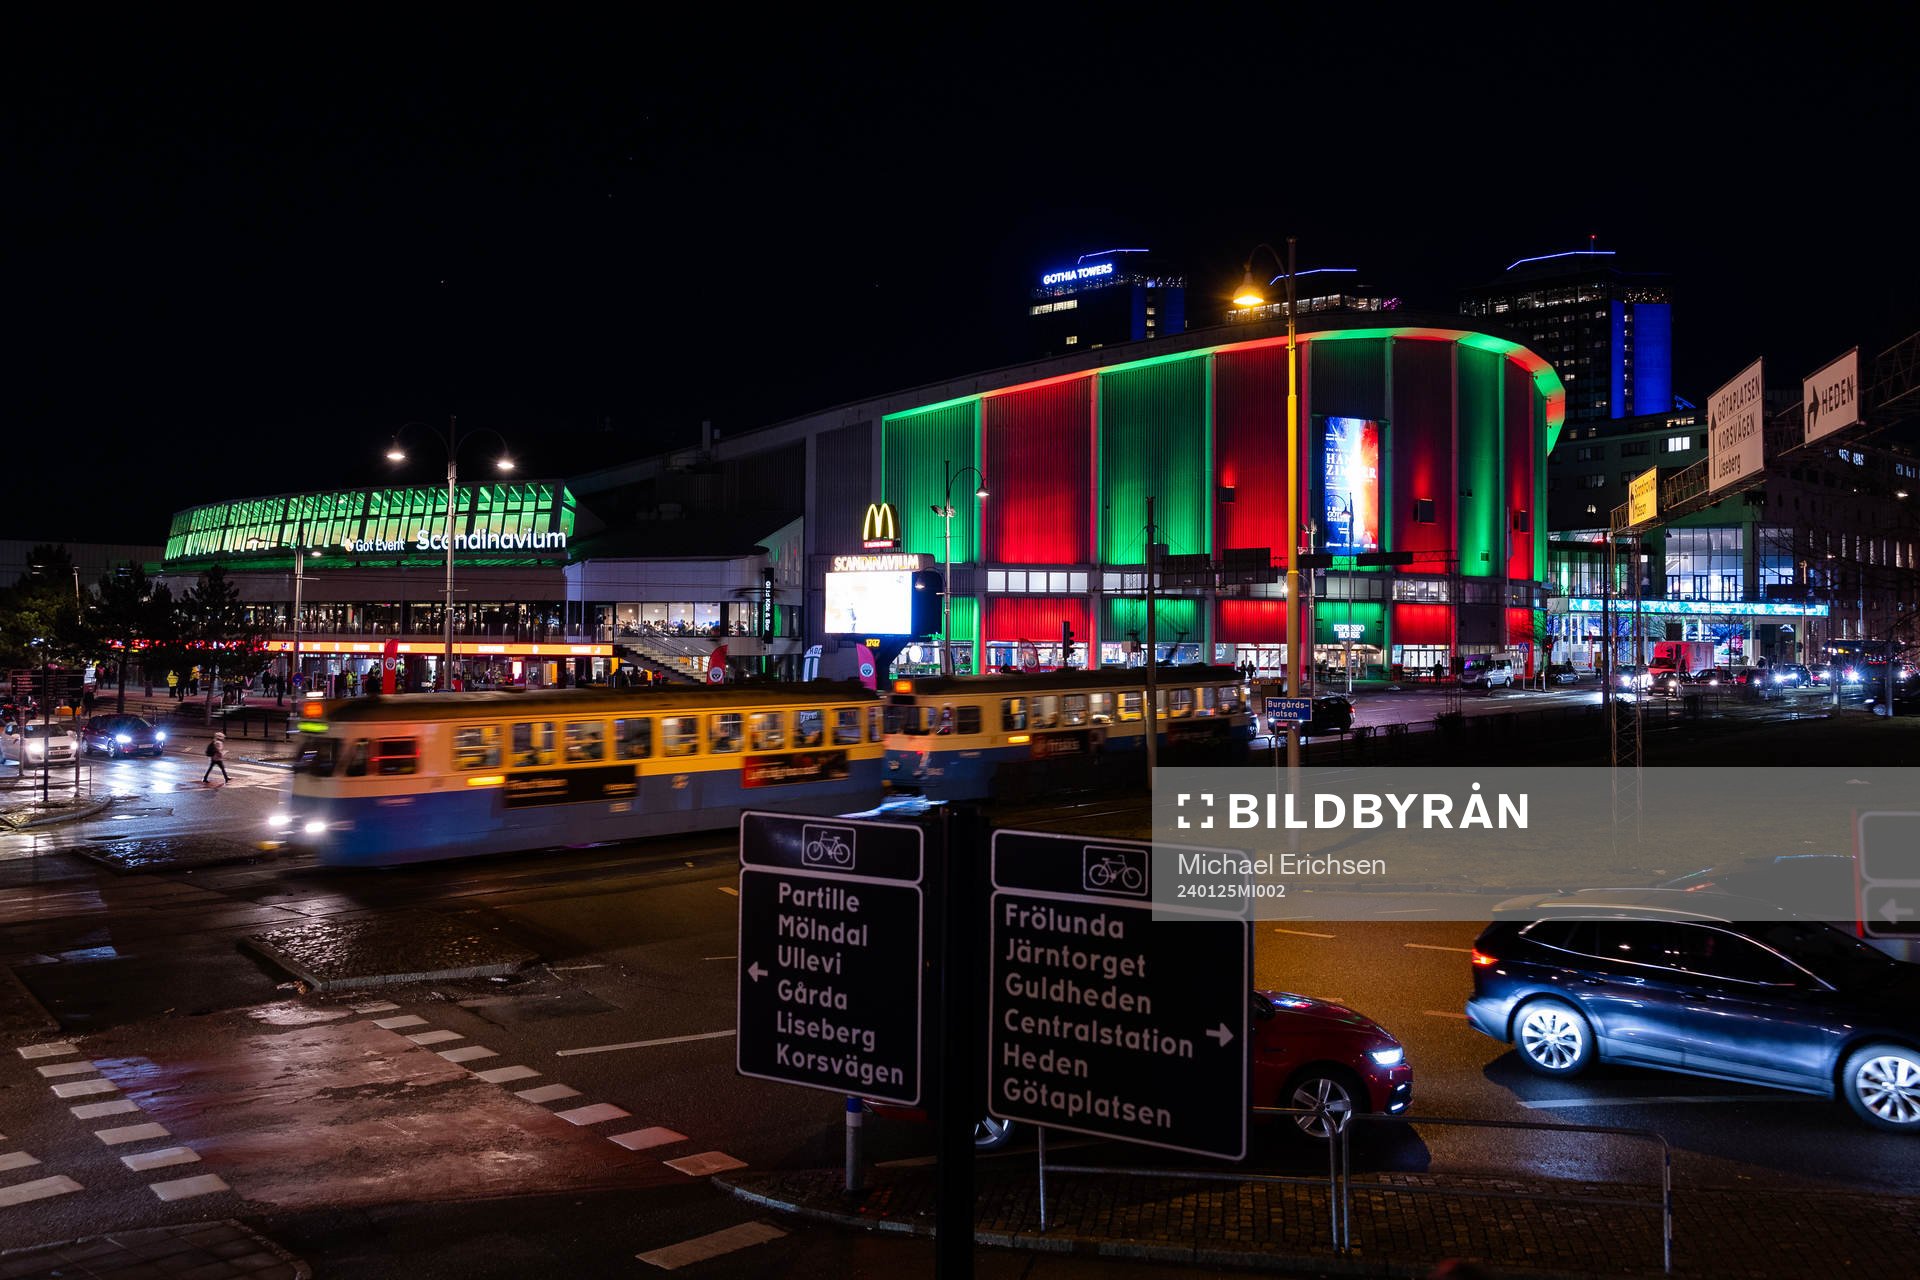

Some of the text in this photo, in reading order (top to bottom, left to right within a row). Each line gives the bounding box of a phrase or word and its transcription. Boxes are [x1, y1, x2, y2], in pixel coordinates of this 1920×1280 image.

[1043, 263, 1113, 285] GOTHIA TOWERS
[1717, 374, 1760, 422] GÖTAPLATSEN
[1821, 374, 1854, 416] HEDEN
[1718, 412, 1755, 451] KORSVÄGEN
[1718, 453, 1741, 478] Liseberg
[355, 539, 405, 551] Got Event
[416, 529, 566, 550] Scandinavium
[834, 555, 920, 571] SCANDINAVIUM
[1268, 700, 1310, 710] Burgårds-
[1268, 709, 1298, 718] platsen
[779, 882, 860, 912] Partille
[778, 914, 868, 947] Mölndal
[1005, 903, 1124, 939] Frölunda
[778, 945, 841, 975] Ullevi
[1006, 938, 1146, 979] Järntorget
[778, 979, 848, 1010] Gårda
[1005, 973, 1151, 1014] Guldheden
[777, 1010, 875, 1052] Liseberg
[1004, 1009, 1193, 1058] Centralstation
[777, 1043, 904, 1085] Korsvägen
[1003, 1043, 1088, 1078] Heden
[1003, 1078, 1171, 1128] Götaplatsen
